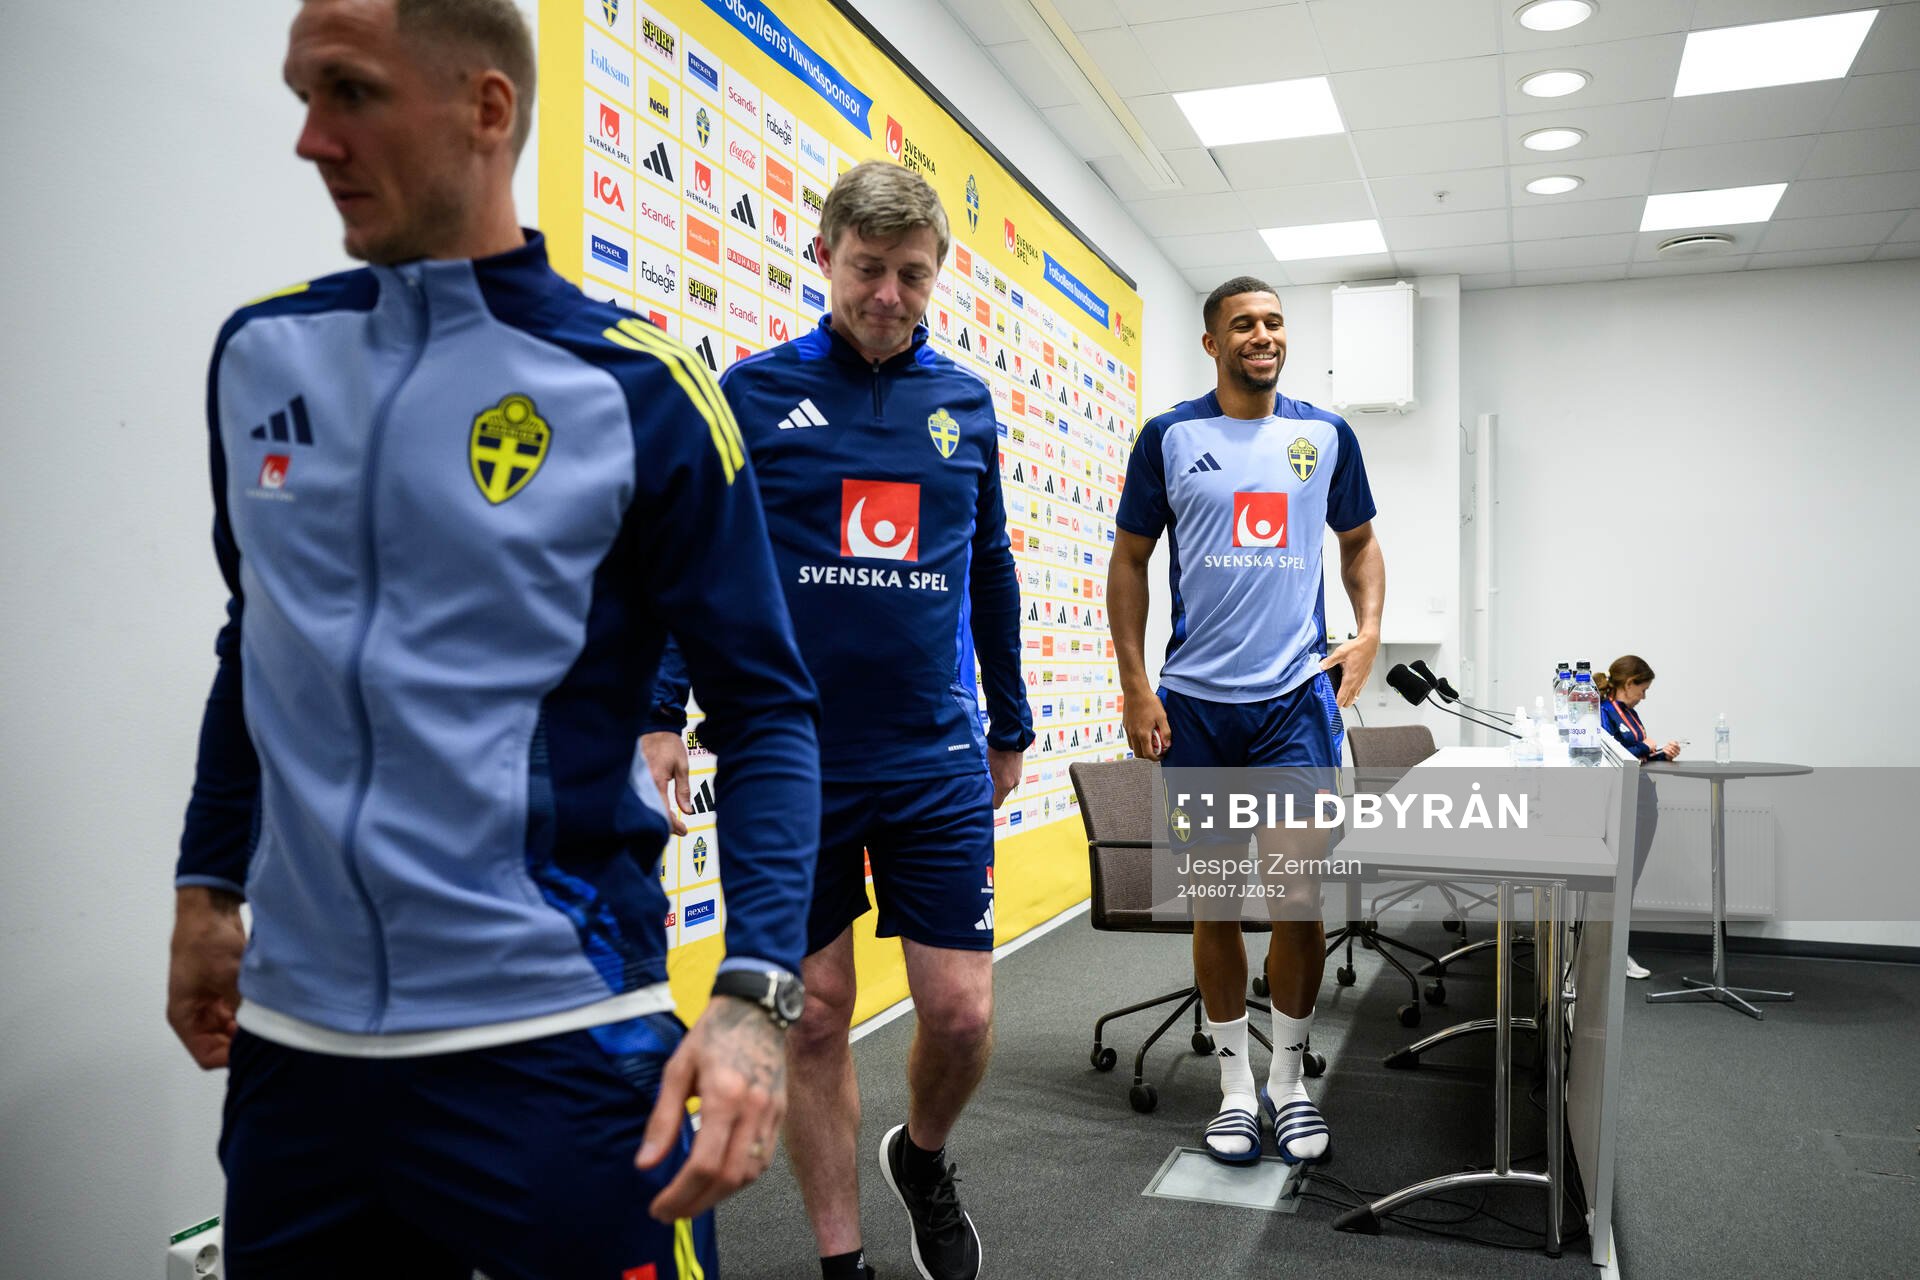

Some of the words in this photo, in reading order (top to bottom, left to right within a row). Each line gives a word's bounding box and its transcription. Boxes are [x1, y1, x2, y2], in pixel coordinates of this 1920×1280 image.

[642, 16, 675, 53] SPORT
[643, 37, 674, 61] BLADET
[718, 0, 787, 54] otbollens
[788, 38, 861, 118] huvudsponsor
[590, 48, 630, 88] Folksam
[728, 86, 757, 117] Scandic
[766, 113, 792, 146] Fabege
[588, 134, 616, 157] SVENSKA
[617, 150, 631, 164] SPEL
[904, 138, 936, 176] SVENSKA
[593, 170, 625, 212] ICA
[686, 189, 709, 208] SVENSKA
[709, 203, 721, 214] SPEL
[641, 202, 676, 231] Scandic
[765, 235, 784, 252] SVENSKA
[1016, 234, 1039, 260] SVENSKA
[1016, 247, 1029, 265] SPEL
[728, 249, 760, 275] BAUHAUS
[641, 261, 675, 294] Fabege
[767, 263, 792, 290] SPORT
[688, 277, 718, 306] SPORT
[689, 297, 716, 313] BLADET
[729, 302, 758, 326] Scandic
[769, 315, 789, 342] ICA
[1204, 555, 1274, 568] SVENSKA
[1278, 555, 1305, 570] SPEL
[798, 565, 903, 588] SVENSKA
[909, 571, 949, 592] SPEL
